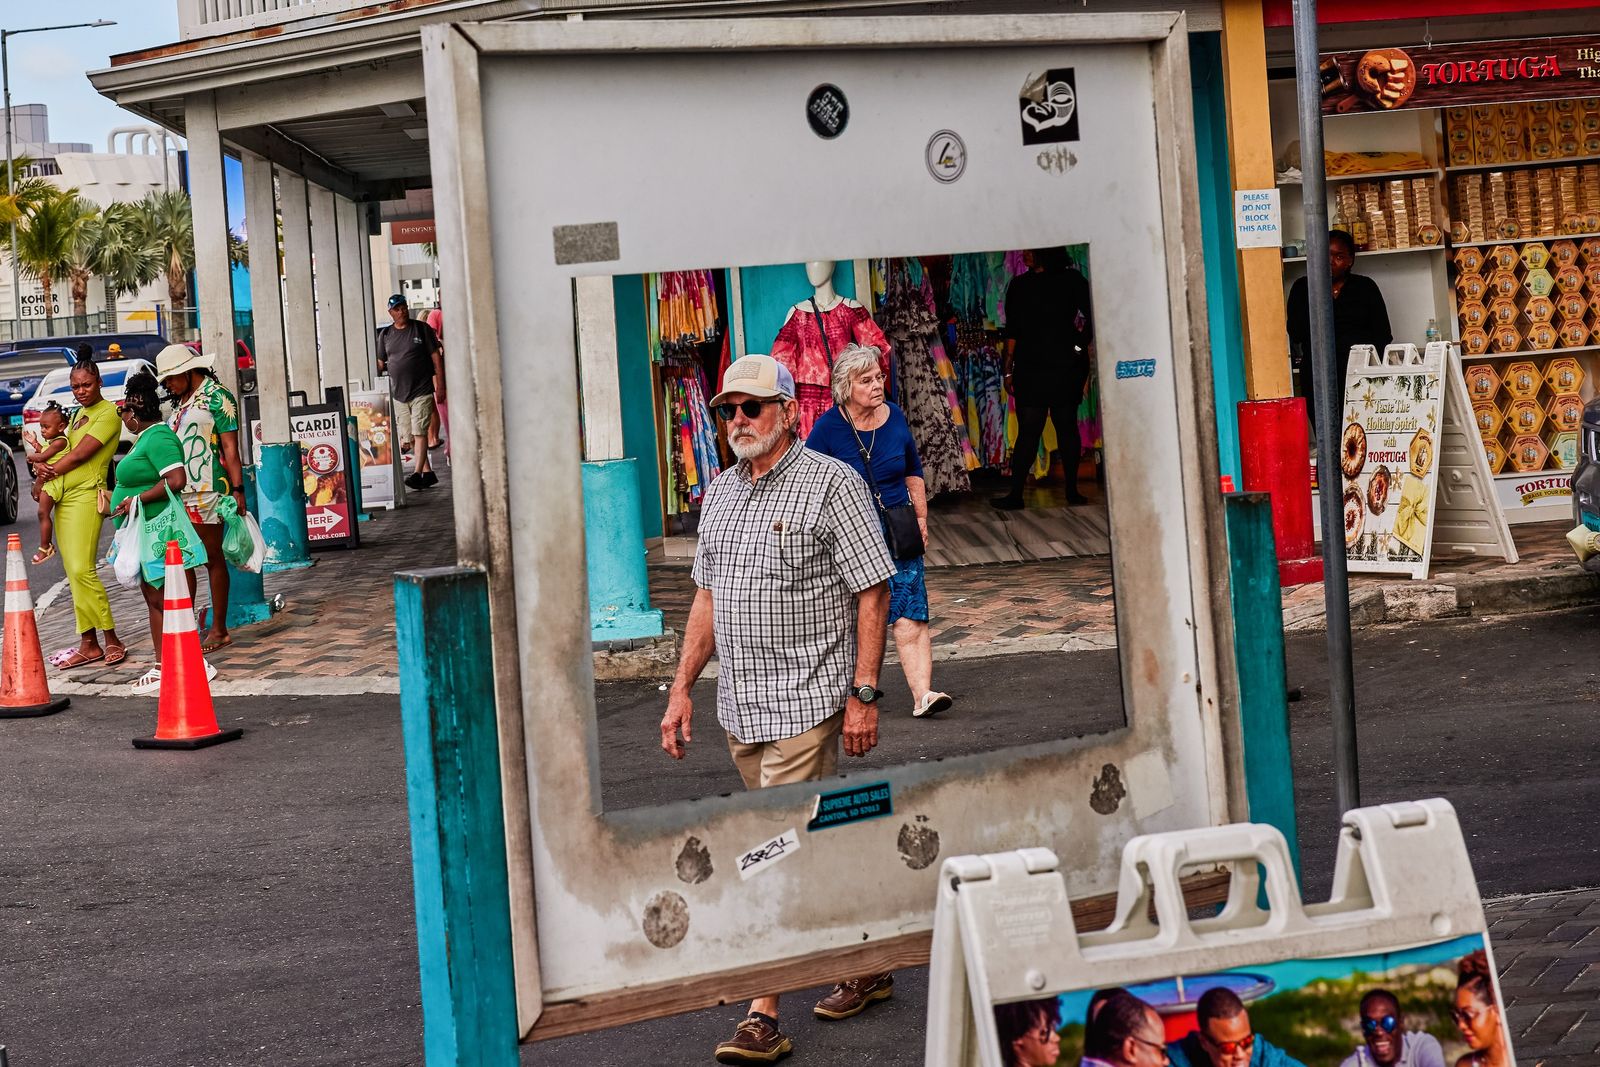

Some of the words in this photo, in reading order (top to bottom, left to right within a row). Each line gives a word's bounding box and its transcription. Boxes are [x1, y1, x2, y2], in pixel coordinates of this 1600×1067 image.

[1421, 55, 1562, 86] TORTUGA
[1245, 214, 1270, 222] BLOCK
[21, 294, 58, 304] KOHLR
[34, 304, 60, 315] SDO
[1375, 400, 1394, 414] Taste
[1395, 400, 1411, 414] The
[1366, 417, 1395, 434] Holiday
[1395, 416, 1418, 433] Spirit
[316, 430, 337, 438] CAKE
[1384, 436, 1397, 447] with
[1368, 451, 1407, 463] TORTUGA
[1527, 492, 1543, 500] RAISE
[822, 795, 852, 811] SUPREME
[853, 791, 870, 804] AUTO
[870, 788, 889, 801] SALES
